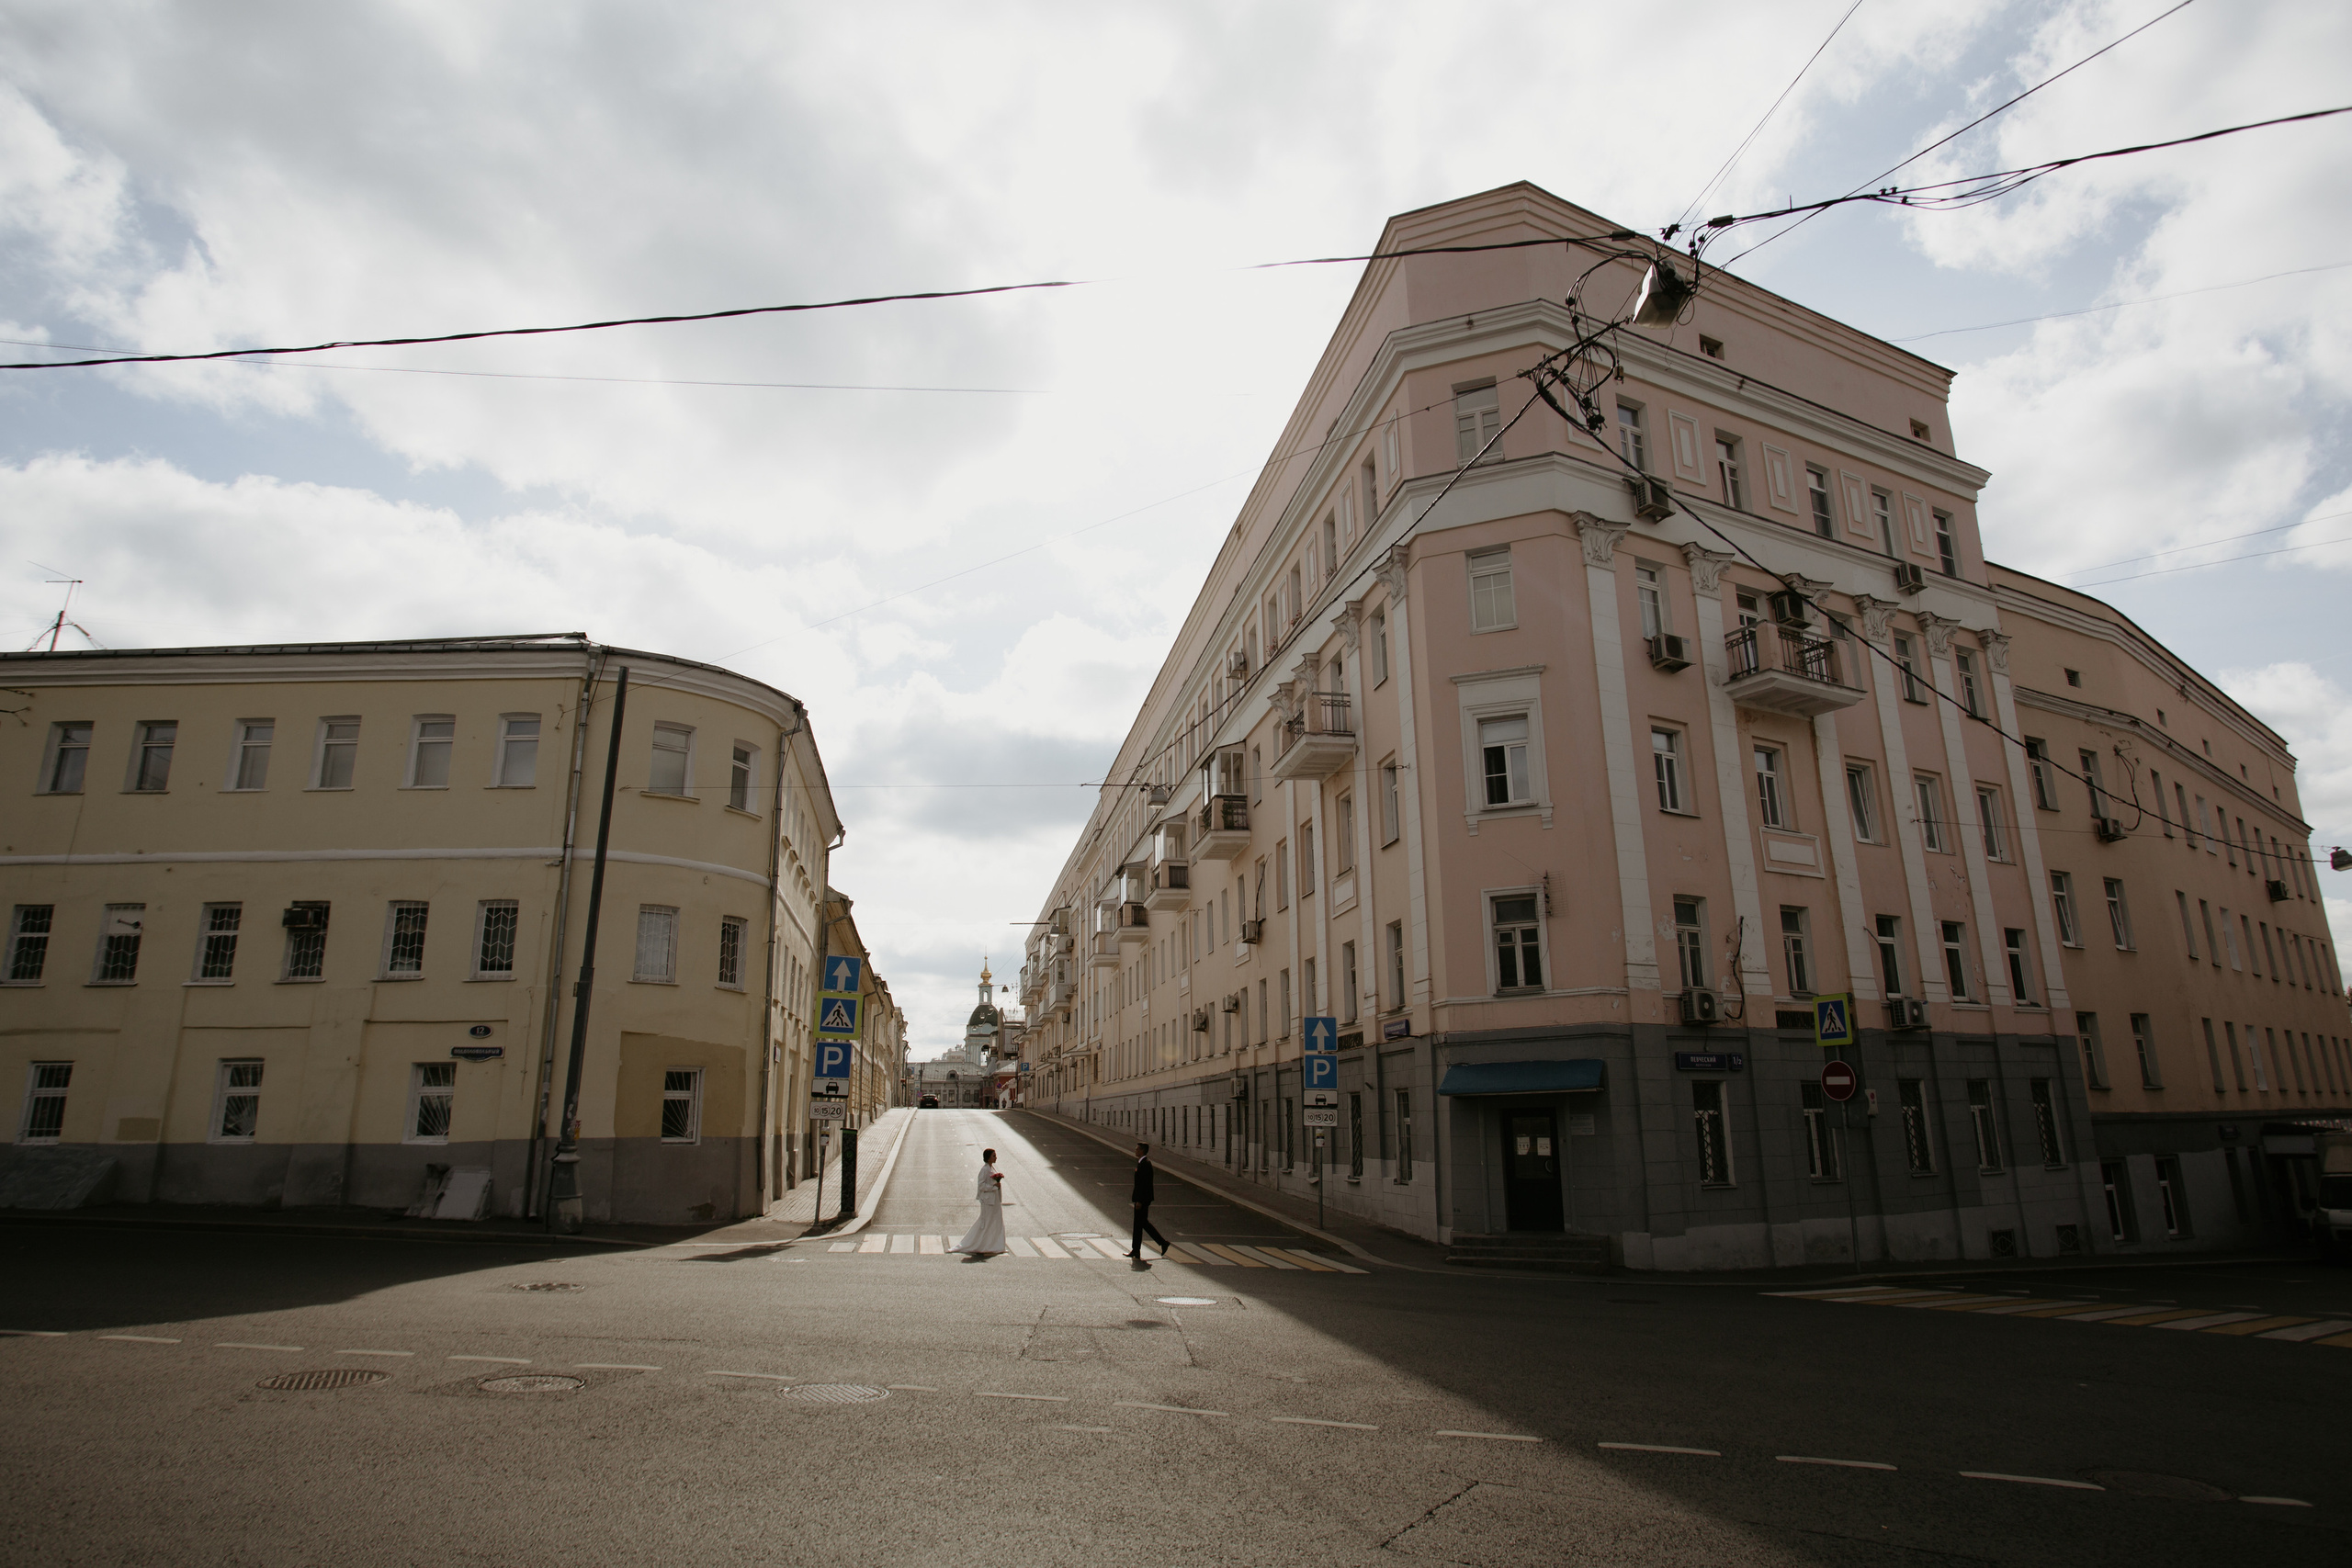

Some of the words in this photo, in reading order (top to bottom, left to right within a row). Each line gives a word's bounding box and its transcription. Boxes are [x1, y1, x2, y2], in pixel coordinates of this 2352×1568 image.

[822, 1046, 843, 1075] P
[1733, 1055, 1743, 1066] 1/2
[1313, 1059, 1330, 1085] P
[831, 1107, 842, 1115] 20
[1324, 1113, 1334, 1122] 20
